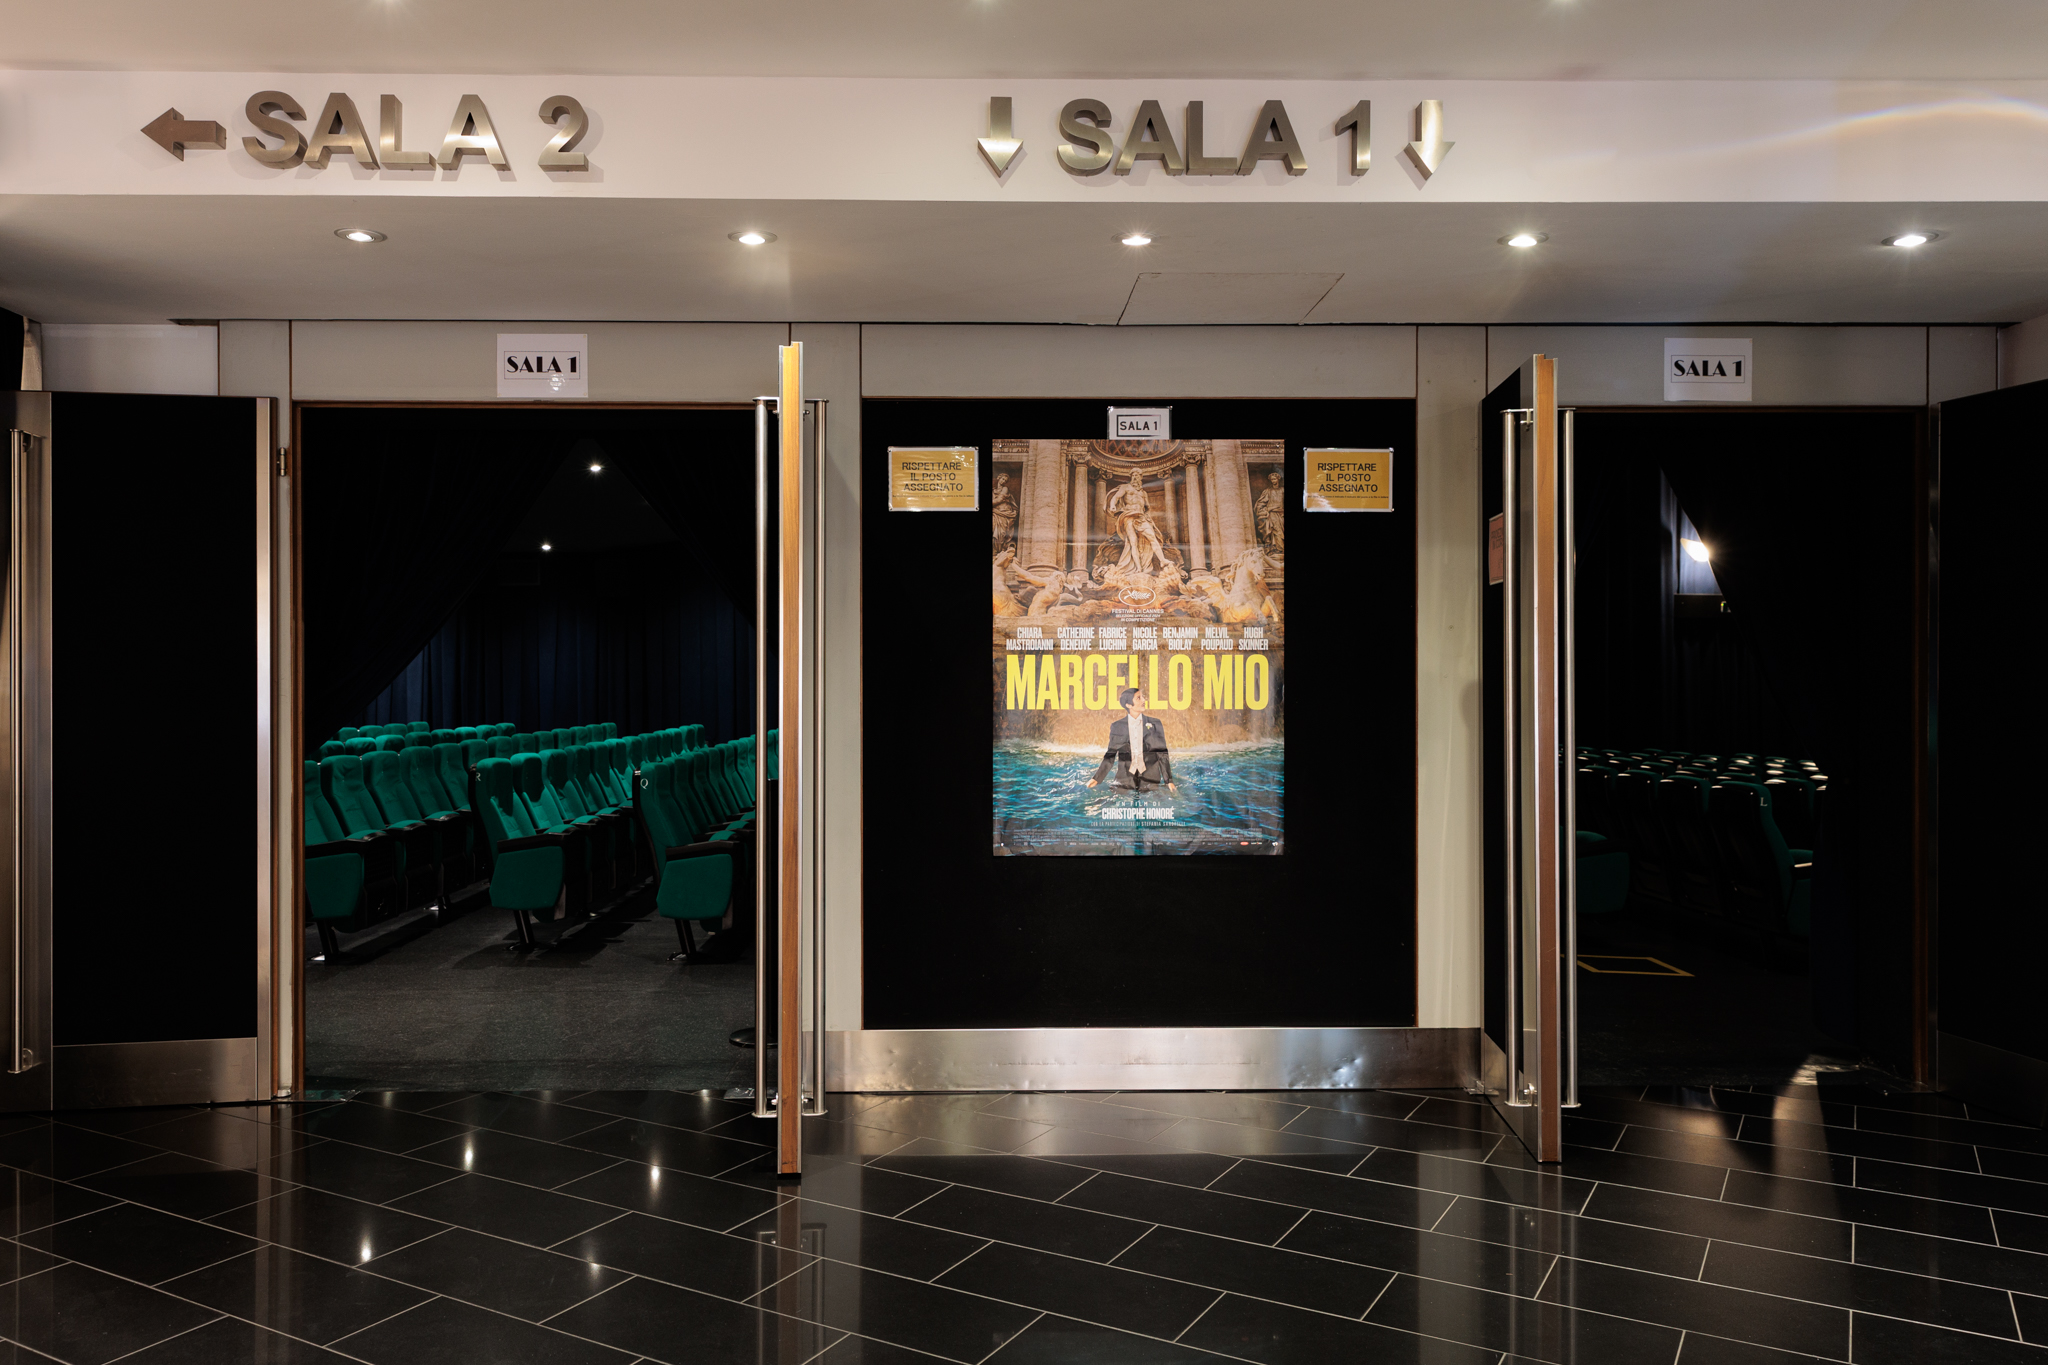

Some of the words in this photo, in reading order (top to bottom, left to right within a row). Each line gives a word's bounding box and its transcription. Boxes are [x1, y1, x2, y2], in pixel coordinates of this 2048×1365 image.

[242, 90, 510, 171] SALA
[538, 95, 588, 171] 2
[1056, 98, 1308, 177] SALA
[1335, 100, 1370, 177] 1
[507, 355, 562, 373] SALA
[567, 356, 577, 373] 1
[1673, 359, 1727, 377] SALA
[1732, 360, 1742, 377] 1
[1119, 420, 1150, 431] SALA
[1153, 421, 1158, 431] 1
[901, 461, 962, 471] RISPETTARE
[1317, 462, 1377, 472] RISPETTARE
[910, 472, 920, 481] IL
[922, 472, 957, 481] POSTO
[1325, 473, 1335, 482] IL
[1337, 473, 1372, 482] POSTO
[903, 482, 964, 492] ASSEGNATO
[1318, 483, 1379, 493] ASSEGNATO
[1017, 626, 1043, 639] CHIARA
[1057, 626, 1095, 639] CATHERINE
[1098, 626, 1127, 639] FABRICE
[1132, 626, 1158, 639] NICOLE
[1162, 626, 1198, 639] BENJAMIN
[1205, 626, 1229, 639] MELVIL
[1243, 626, 1264, 639] HUGH
[1006, 638, 1054, 650] MASTROIANNI
[1060, 638, 1092, 650] DENEUVE
[1098, 638, 1127, 650] LUCHINI
[1132, 638, 1158, 650] GARCIA
[1168, 638, 1193, 650] BIOLAY
[1200, 638, 1234, 650] POUPAUD
[1238, 638, 1269, 650] SKINNER
[1006, 654, 1192, 710] MARCELLO
[1203, 654, 1269, 710] MIO
[640, 778, 649, 790] Q
[1760, 796, 1768, 807] L
[1101, 807, 1146, 820] CHRISTOPHE
[1146, 806, 1175, 820] HONORÉ
